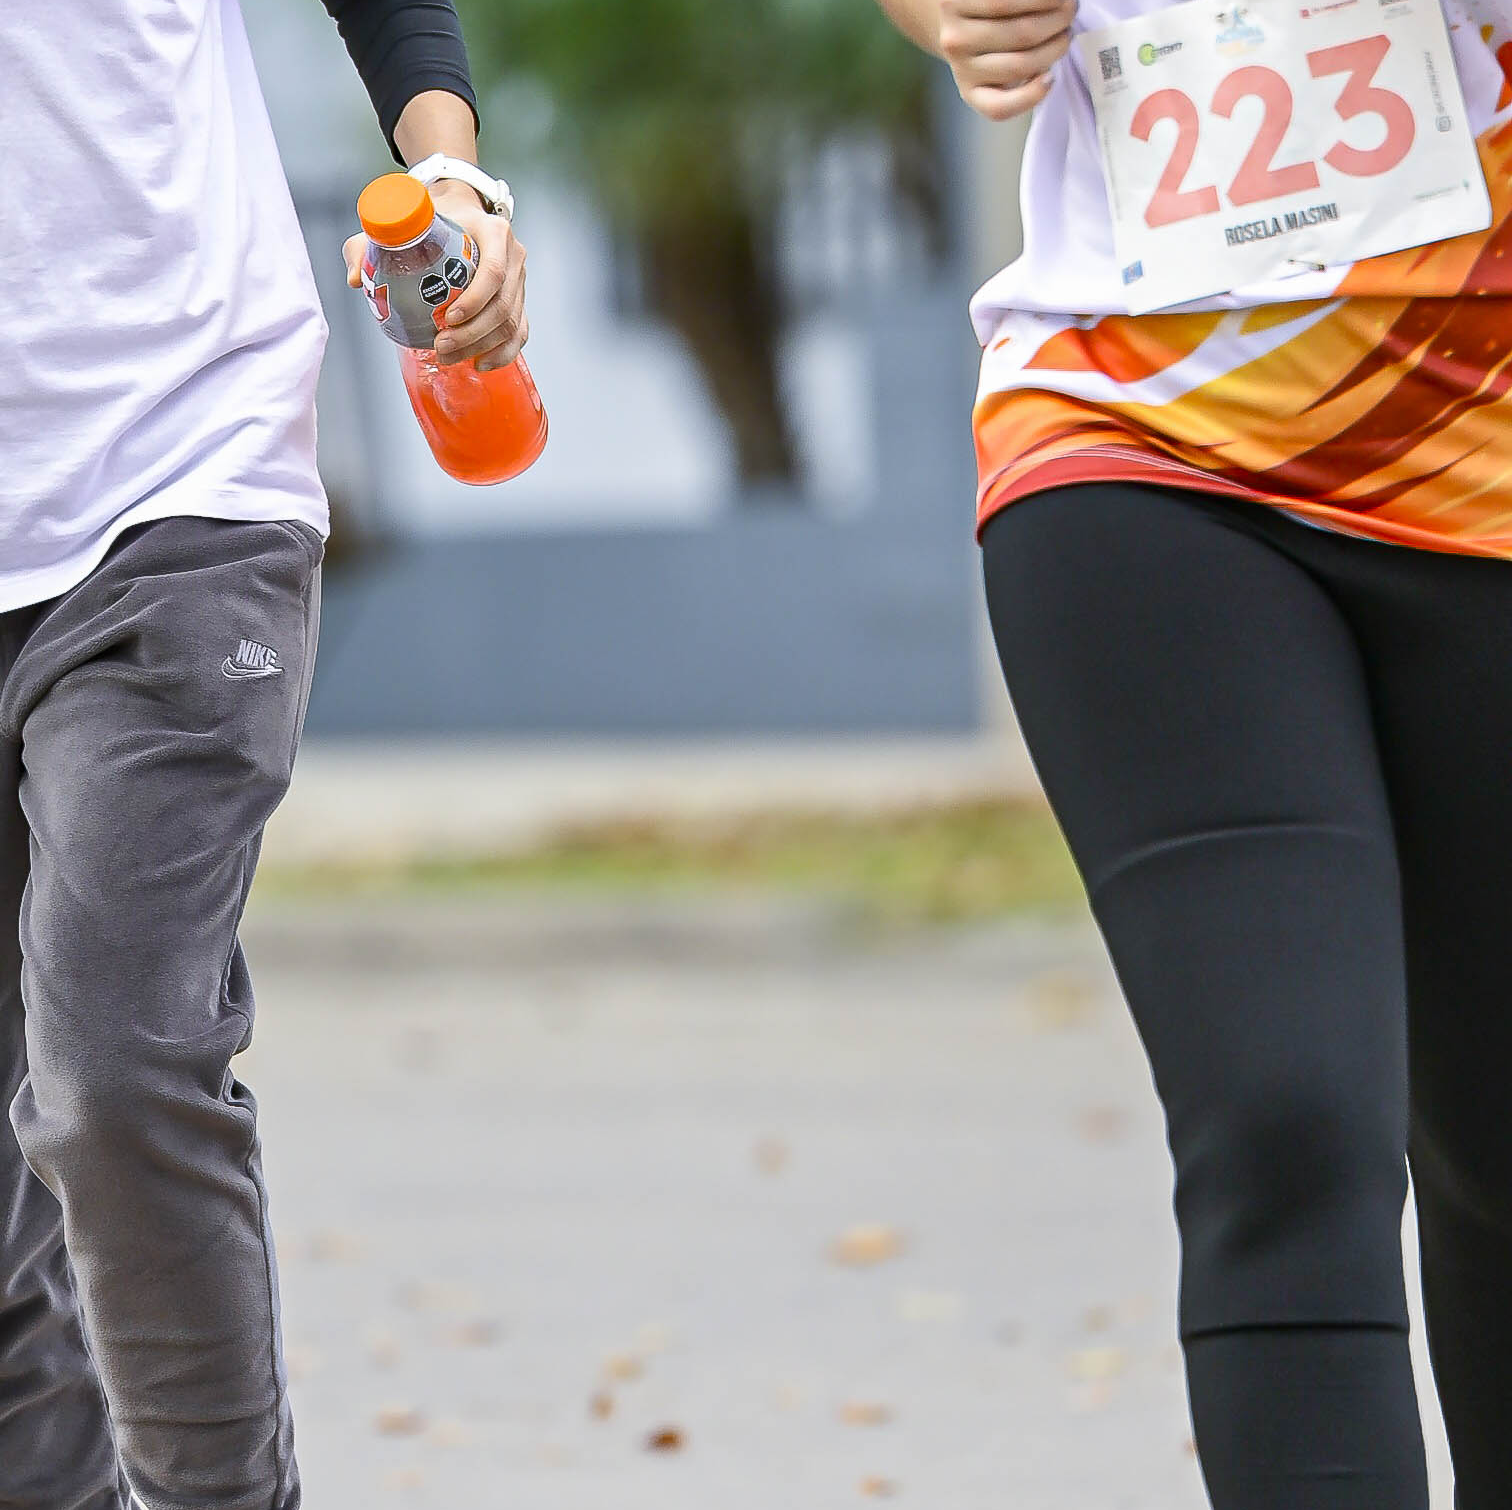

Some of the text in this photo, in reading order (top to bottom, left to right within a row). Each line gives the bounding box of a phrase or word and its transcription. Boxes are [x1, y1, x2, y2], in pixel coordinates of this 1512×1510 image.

[1129, 34, 1416, 229] 223
[1224, 202, 1338, 247] ROSELA MASINI
[235, 638, 278, 668] NIKE
